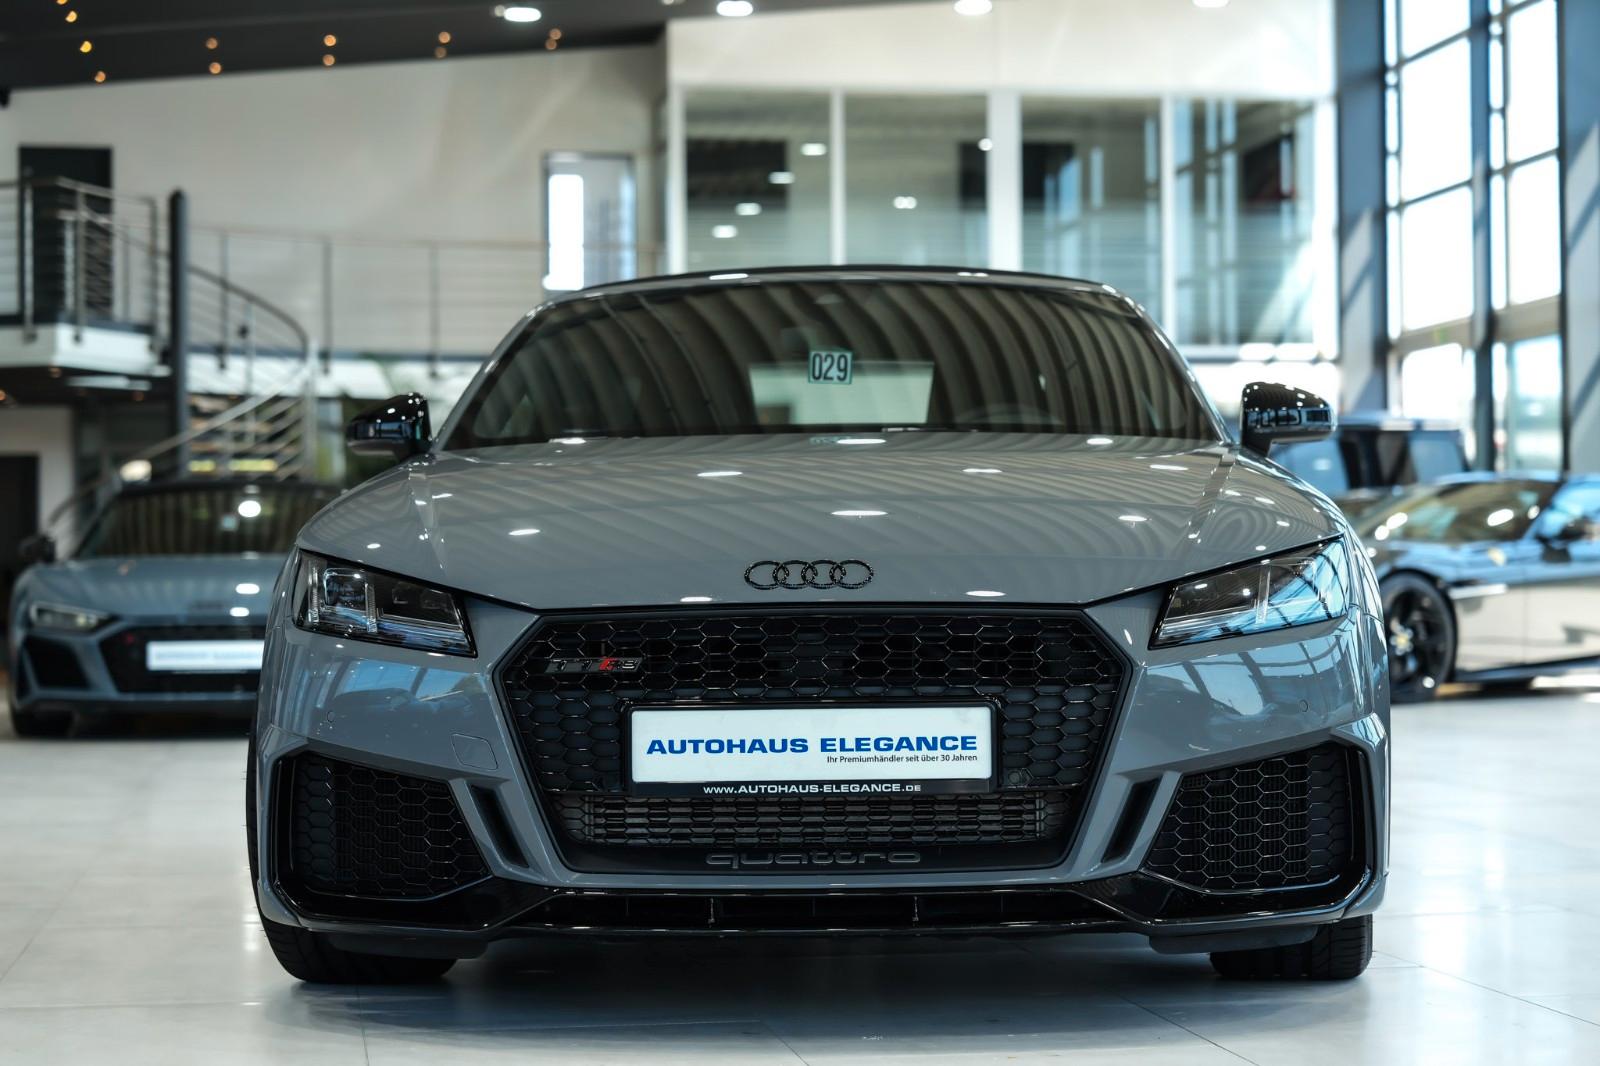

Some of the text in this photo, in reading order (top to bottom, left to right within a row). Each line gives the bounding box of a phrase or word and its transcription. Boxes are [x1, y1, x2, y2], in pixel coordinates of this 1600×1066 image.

[811, 352, 848, 382] 029
[647, 735, 978, 755] AUTOHAUS ELEGANCE
[826, 753, 978, 764] Ihr Premiumhändler seit über 30 Jahren
[703, 783, 922, 794] www.AUTOHAUS-ELEGANCE.DE
[705, 848, 922, 869] quattro
